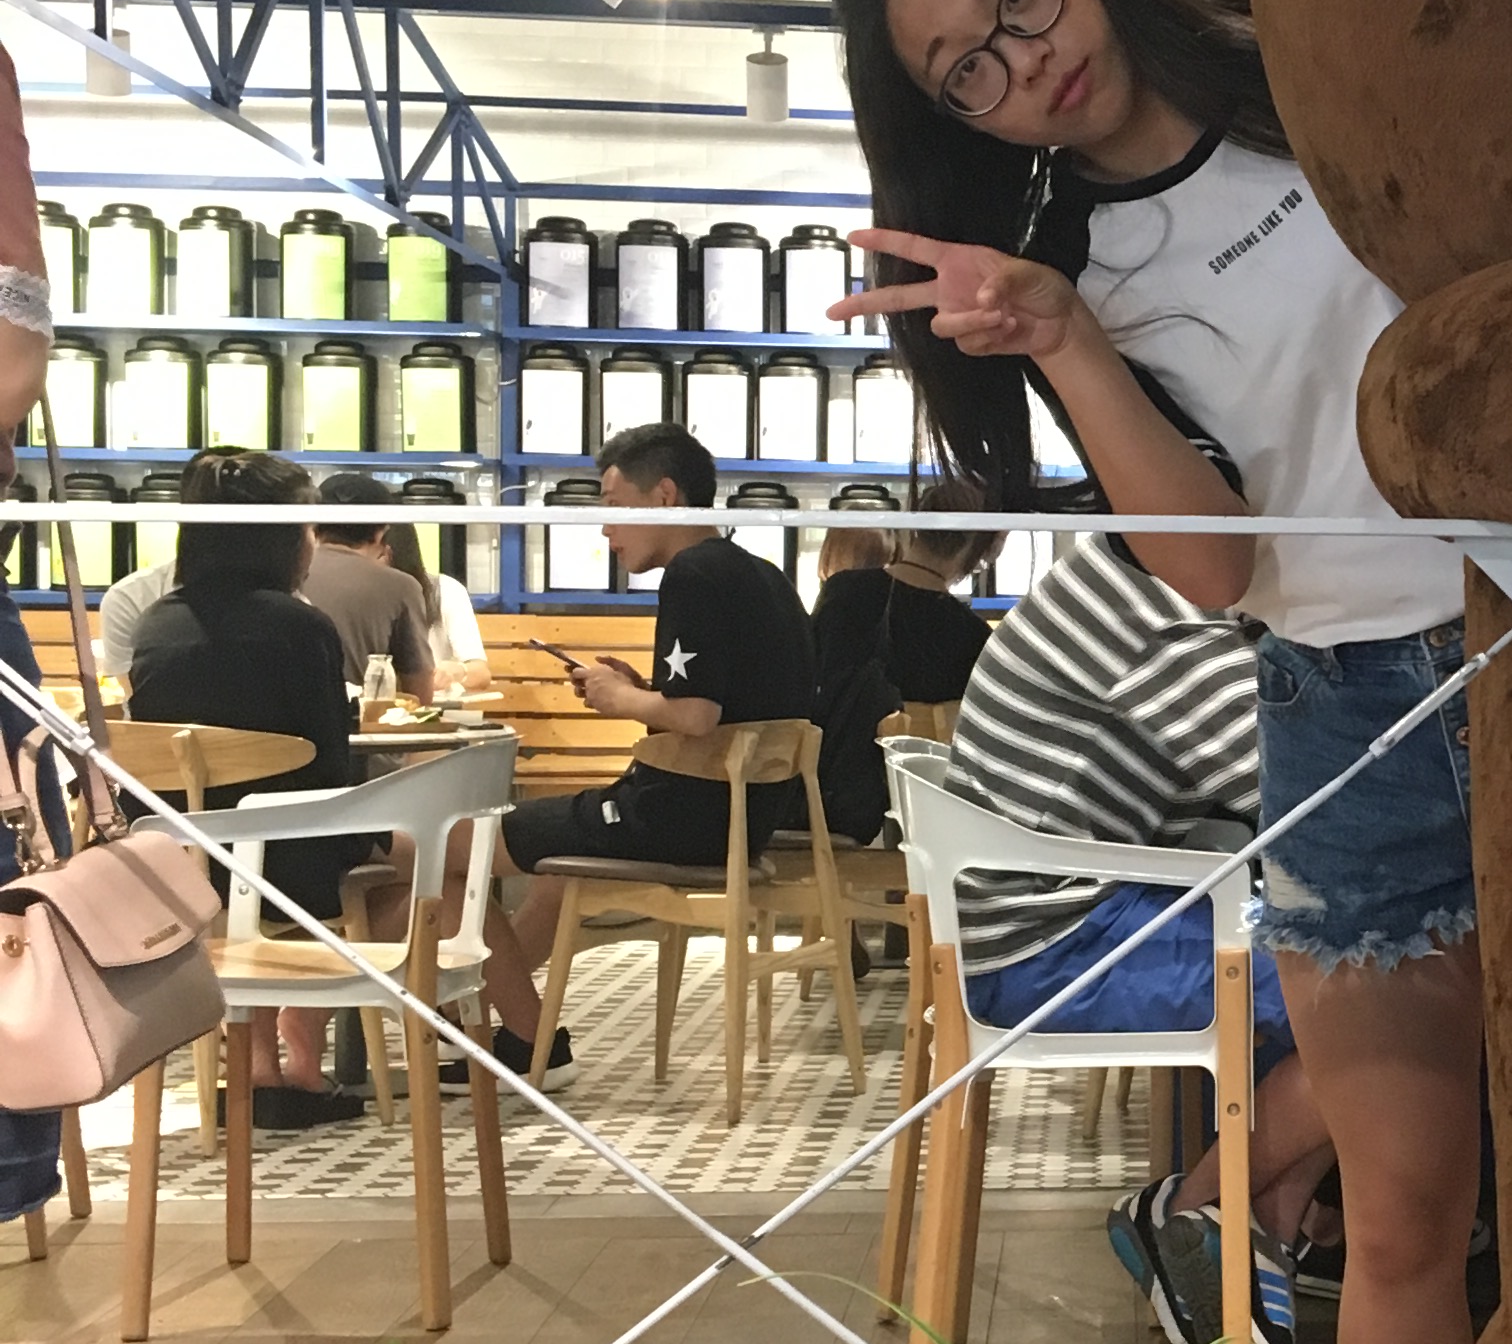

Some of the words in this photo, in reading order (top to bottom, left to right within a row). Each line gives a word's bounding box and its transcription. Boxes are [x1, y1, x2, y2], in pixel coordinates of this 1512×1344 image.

[1208, 230, 1261, 275] SOMEONE
[1257, 209, 1284, 237] LIKE
[1278, 188, 1303, 215] YOU
